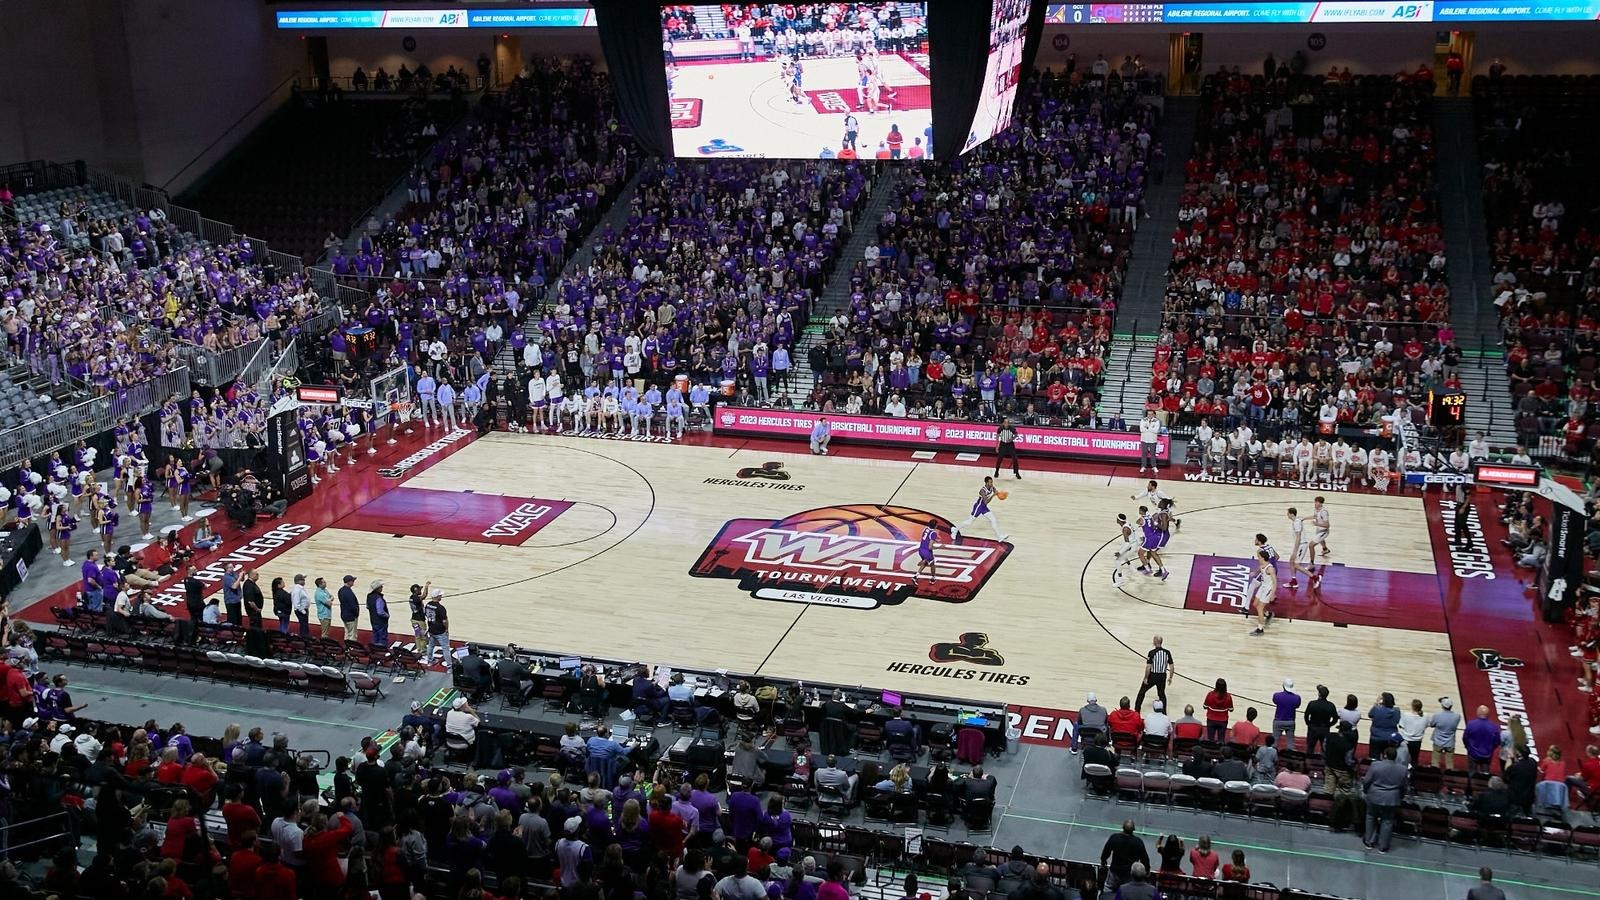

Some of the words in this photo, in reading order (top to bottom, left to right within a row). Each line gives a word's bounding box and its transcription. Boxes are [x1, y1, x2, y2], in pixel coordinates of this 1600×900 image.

[1074, 10, 1082, 22] 0
[1439, 7, 1467, 15] ABILENE
[1468, 7, 1500, 15] REGIONAL
[1501, 7, 1530, 15] AIRPORT.
[1535, 7, 1552, 15] COME
[1554, 7, 1566, 15] FLY
[1566, 7, 1583, 15] WITH
[1442, 395, 1465, 406] 19:32
[1450, 406, 1460, 420] 4
[739, 416, 757, 424] 2023
[758, 417, 792, 427] HERCULES
[793, 419, 812, 428] TIRES
[831, 422, 874, 432] BASKETBALL
[875, 424, 921, 436] TOURNAMENT
[945, 429, 964, 438] 2023
[965, 431, 999, 441] HERCULE
[1025, 435, 1042, 444] WAC
[1044, 436, 1089, 448] BASKETBALL
[1091, 439, 1141, 450] TOURNAMENT
[703, 478, 768, 488] HERCULES
[767, 482, 806, 491] TIRES
[1184, 473, 1348, 492] WACSPORTS.COM
[1424, 475, 1465, 484] GEICO
[481, 502, 552, 538] WAC
[1558, 510, 1571, 558] TicketSmarter
[731, 527, 997, 582] WAC
[756, 570, 908, 592] TOURNAMENT
[1206, 564, 1250, 608] WAC
[782, 591, 809, 601] LAS
[810, 594, 851, 605] VEGAS
[886, 662, 977, 680] HERCULES
[978, 671, 1030, 686] TIRES
